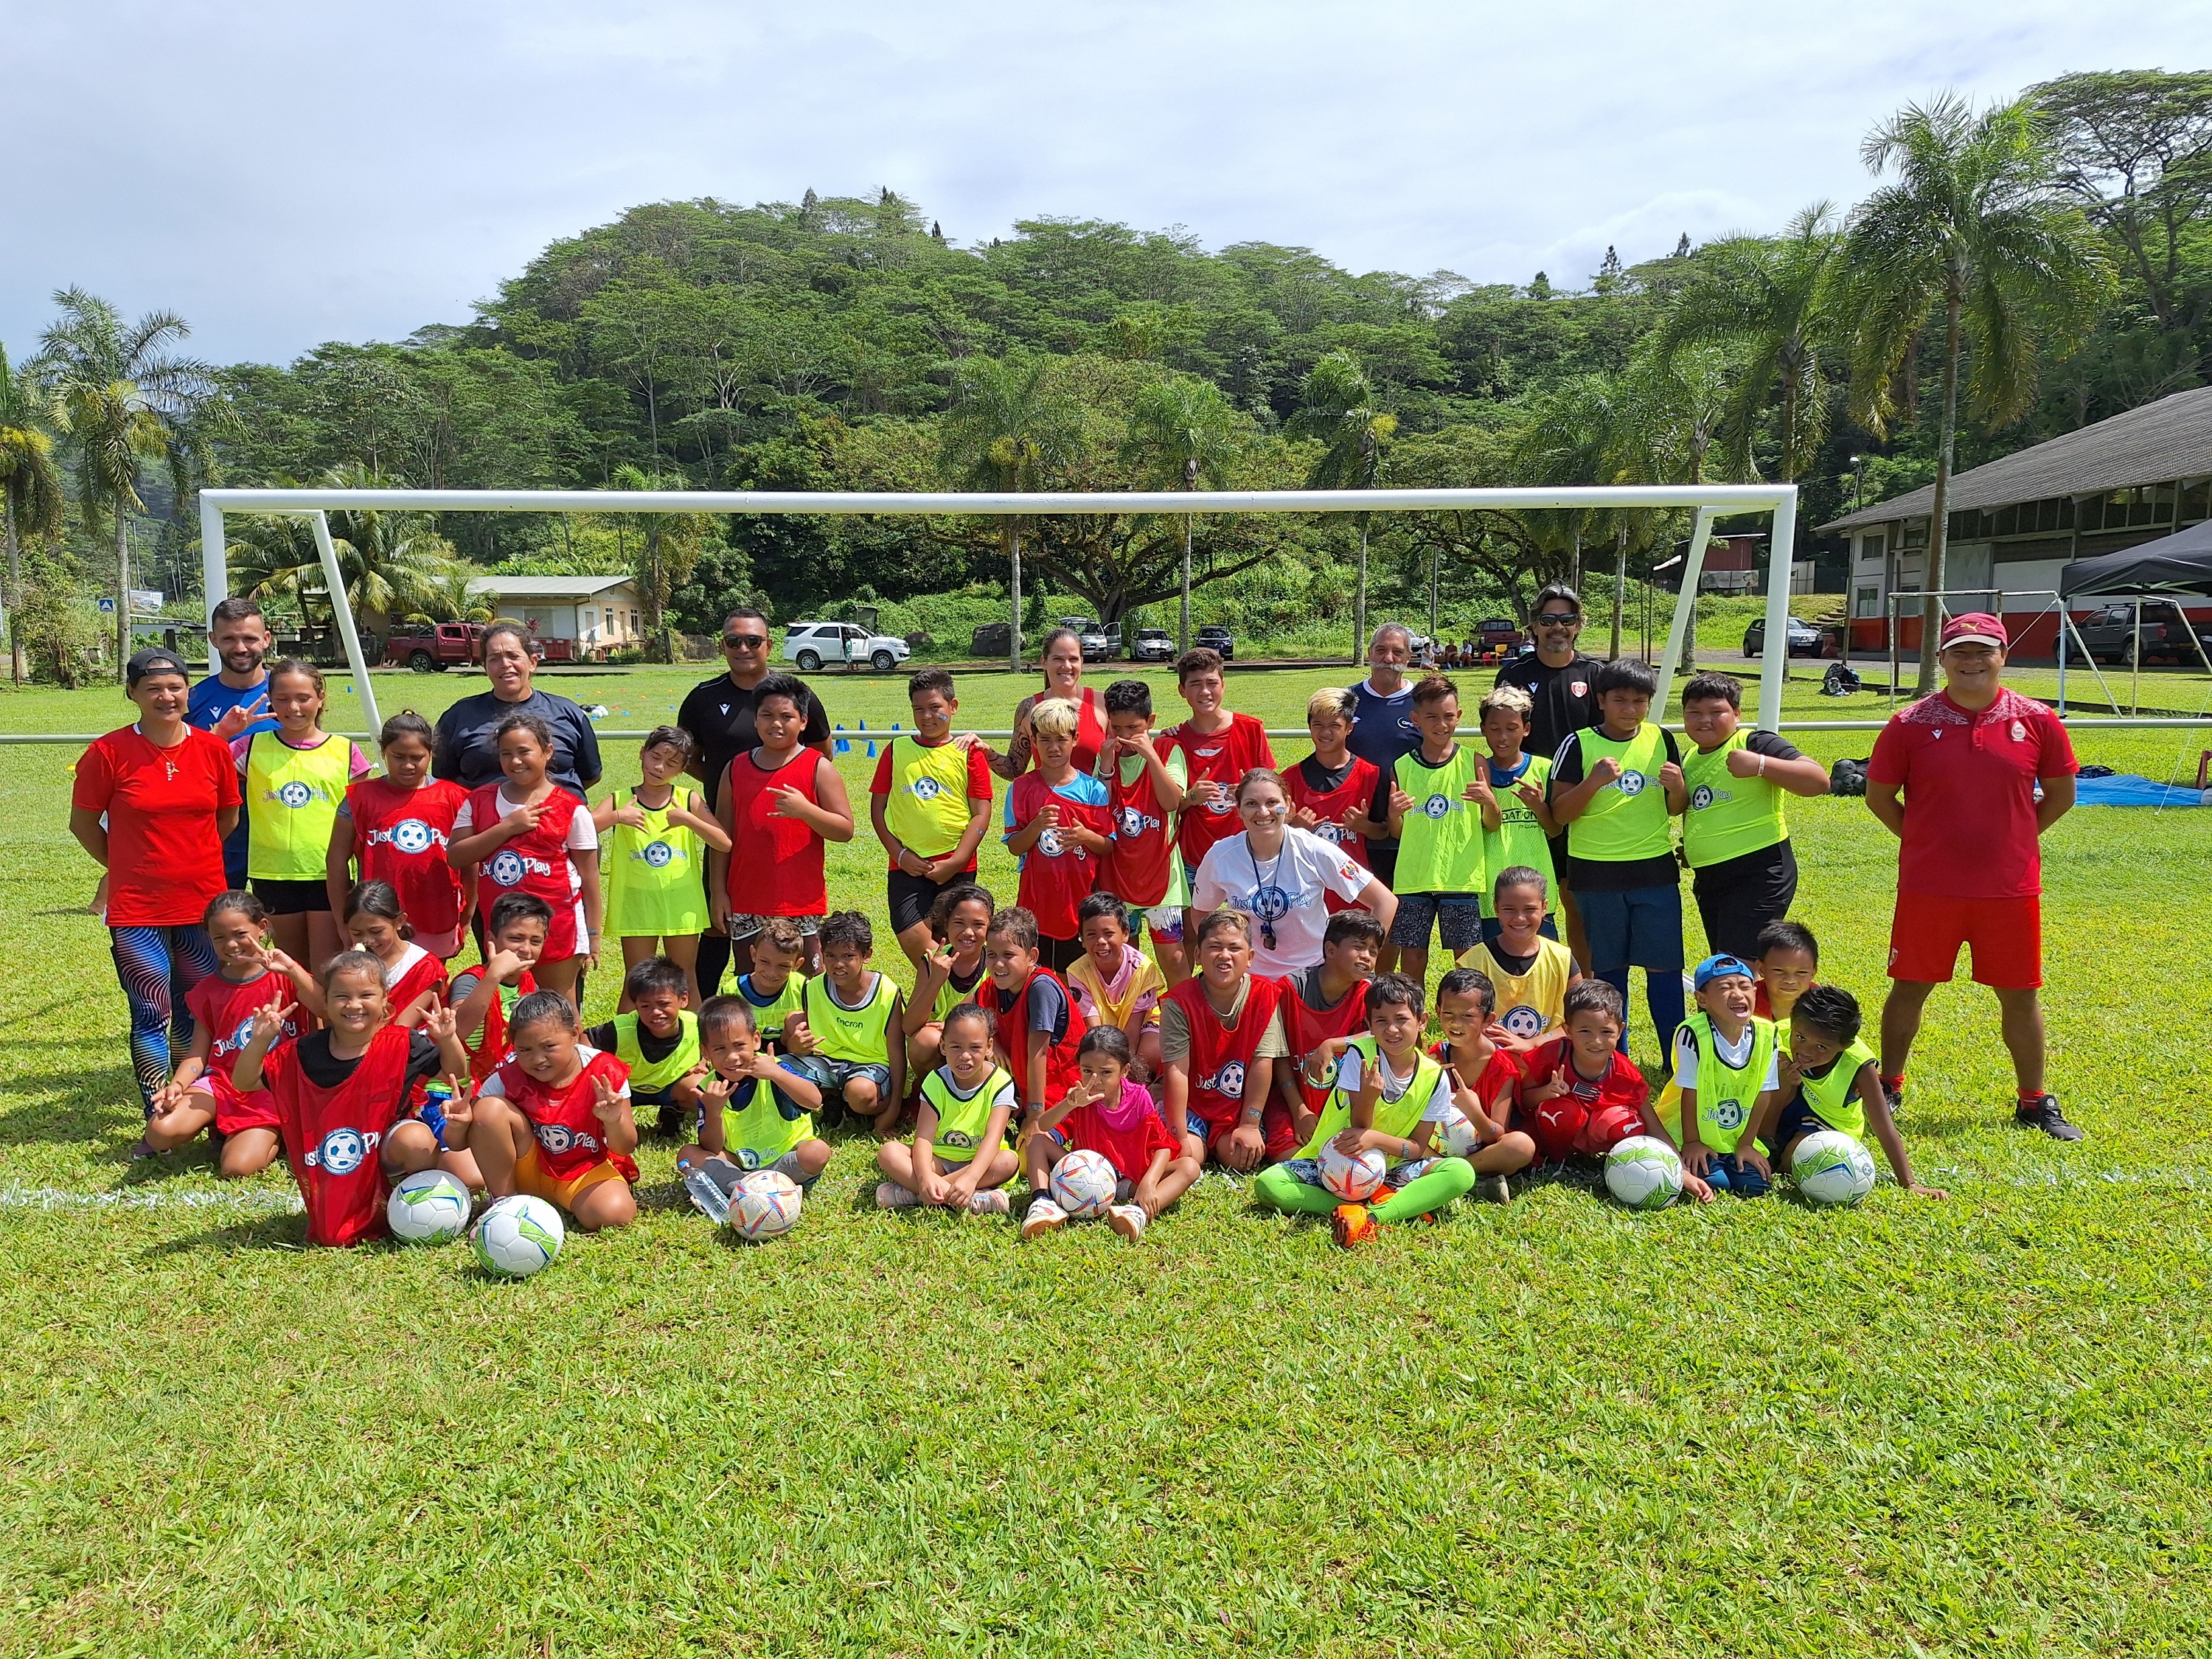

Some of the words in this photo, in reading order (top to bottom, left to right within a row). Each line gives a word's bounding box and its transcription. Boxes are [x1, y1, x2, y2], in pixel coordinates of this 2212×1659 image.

[1645, 775, 1660, 789] Play
[310, 787, 330, 802] Play
[1712, 789, 1733, 801] Play
[1408, 804, 1426, 816] Just
[1449, 800, 1464, 813] Play
[367, 828, 393, 848] Just
[1340, 828, 1357, 844] Play
[1073, 845, 1086, 860] lay
[523, 857, 552, 877] Play
[1232, 895, 1253, 912] Just
[1288, 892, 1312, 909] Play
[213, 1032, 237, 1057] Just
[1195, 1074, 1218, 1090] Just
[1803, 1083, 1821, 1105] Play
[573, 1133, 599, 1152] Play
